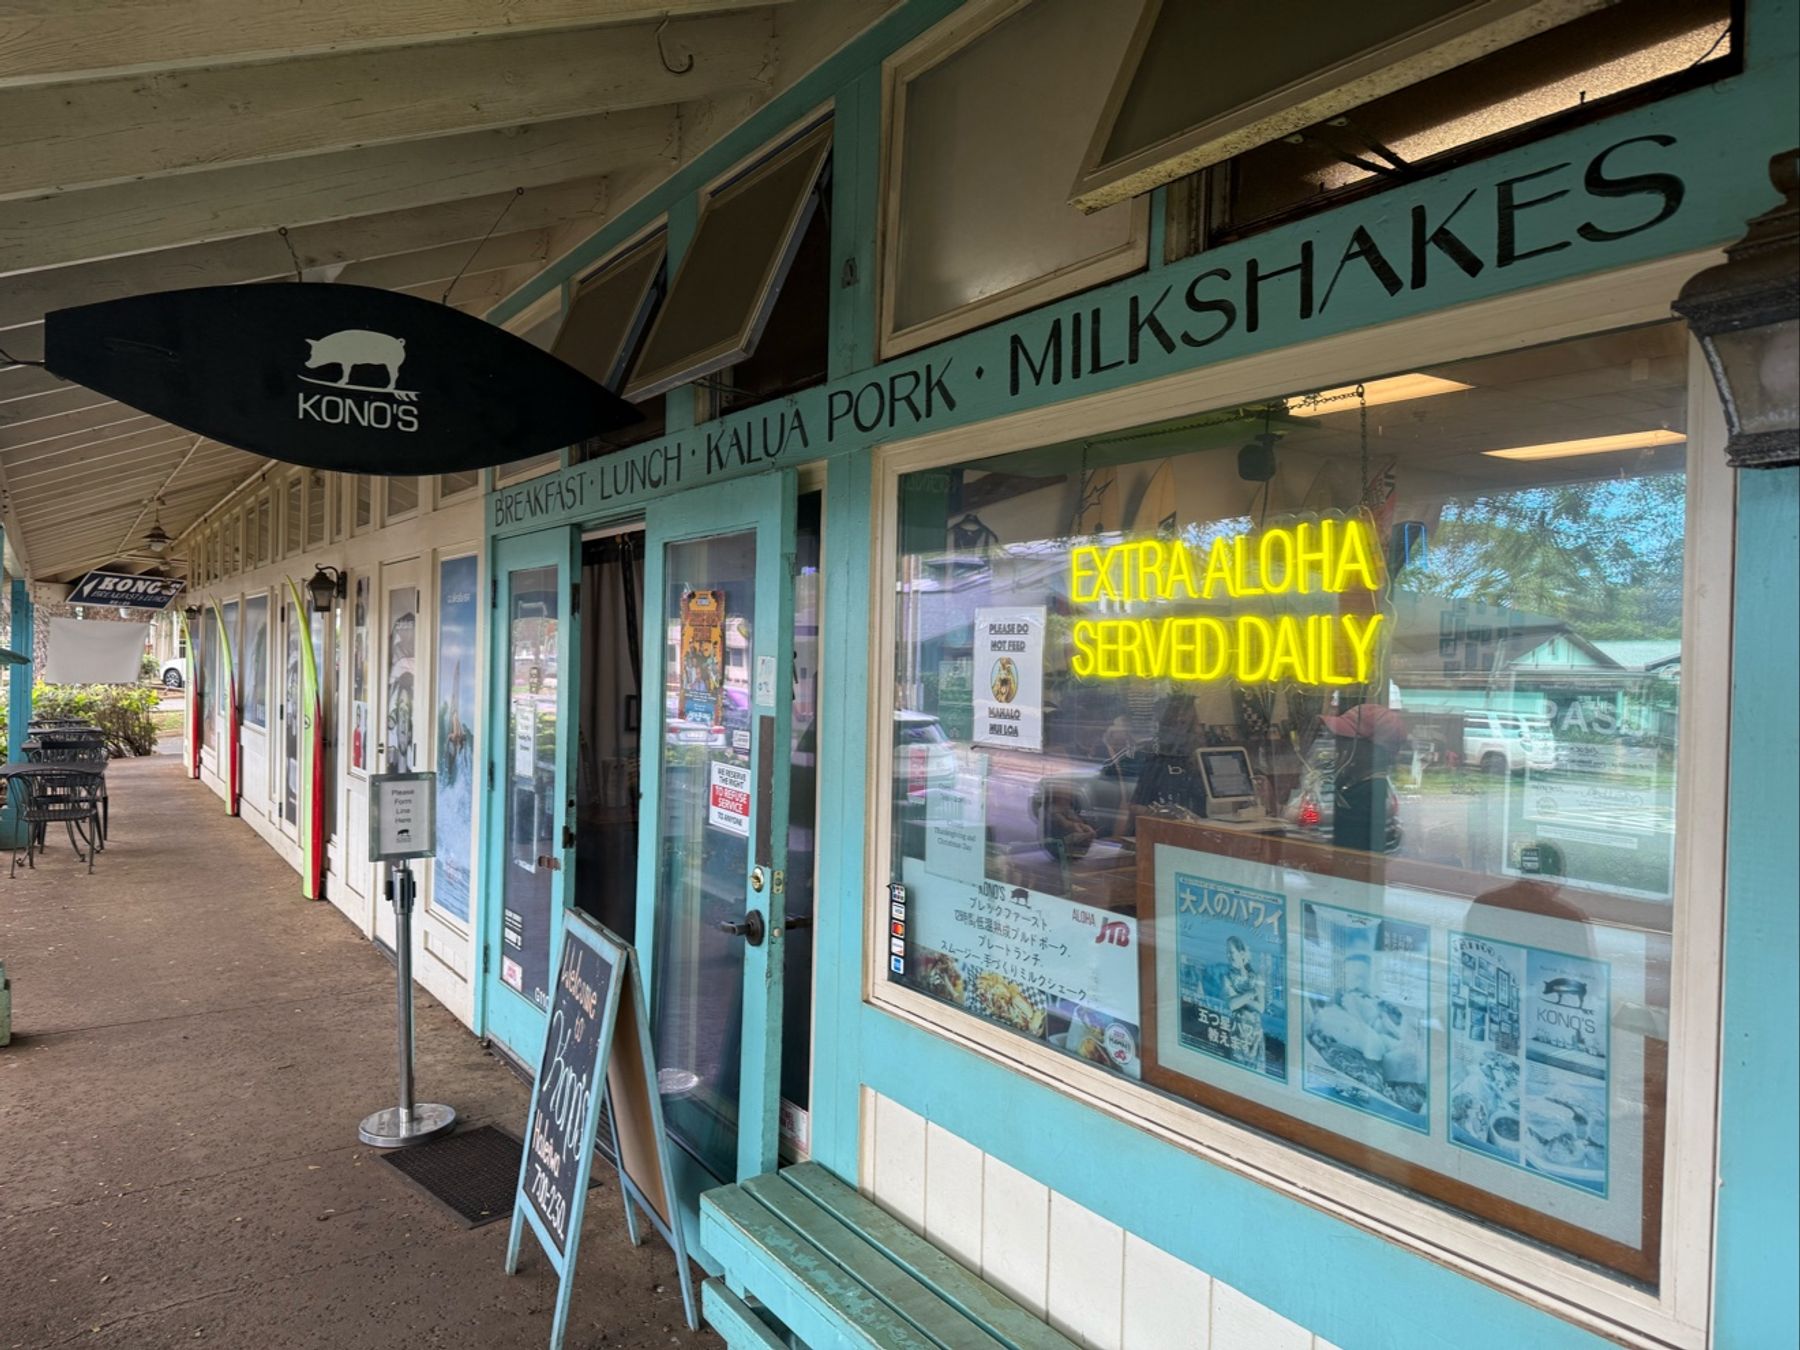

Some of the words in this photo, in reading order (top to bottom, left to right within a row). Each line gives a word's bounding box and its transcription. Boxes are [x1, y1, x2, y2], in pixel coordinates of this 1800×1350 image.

[495, 476, 586, 528] BREAKFAST
[599, 442, 682, 501] LUNCH
[706, 408, 809, 475] KALUA
[827, 357, 957, 443] PORK
[1009, 133, 1686, 398] MILKSHAKES
[298, 392, 419, 433] KONO'S
[1071, 540, 1199, 602] EXTRA
[1202, 519, 1379, 598] ALOHA
[989, 623, 1016, 635] PLEASE
[1016, 624, 1029, 635] DO
[990, 640, 1007, 651] NOT
[1008, 641, 1026, 652] FEED
[1071, 616, 1226, 680] SERVED
[1238, 613, 1384, 685] DAILY
[988, 707, 1021, 720] MAHALO
[989, 723, 1002, 735] NUI
[1003, 725, 1019, 737] LOA
[717, 767, 725, 776] WE
[725, 768, 746, 782] RESERVE
[719, 775, 728, 785] THE
[728, 777, 744, 789] RIGHT
[715, 785, 723, 796] TO
[723, 787, 747, 804] REFUSE
[718, 798, 743, 813] SERVICE
[717, 811, 723, 820] TO
[724, 813, 742, 826] ANYONE
[1072, 907, 1096, 927] ALOHA
[1180, 888, 1283, 935] 大人のハワイ
[1095, 916, 1130, 948] JTB
[561, 938, 597, 1020] Welcome
[573, 1015, 585, 1043] to
[1536, 1006, 1596, 1034] KONO'S
[541, 1009, 592, 1164] Kono's
[532, 1108, 561, 1178] Haleiwa
